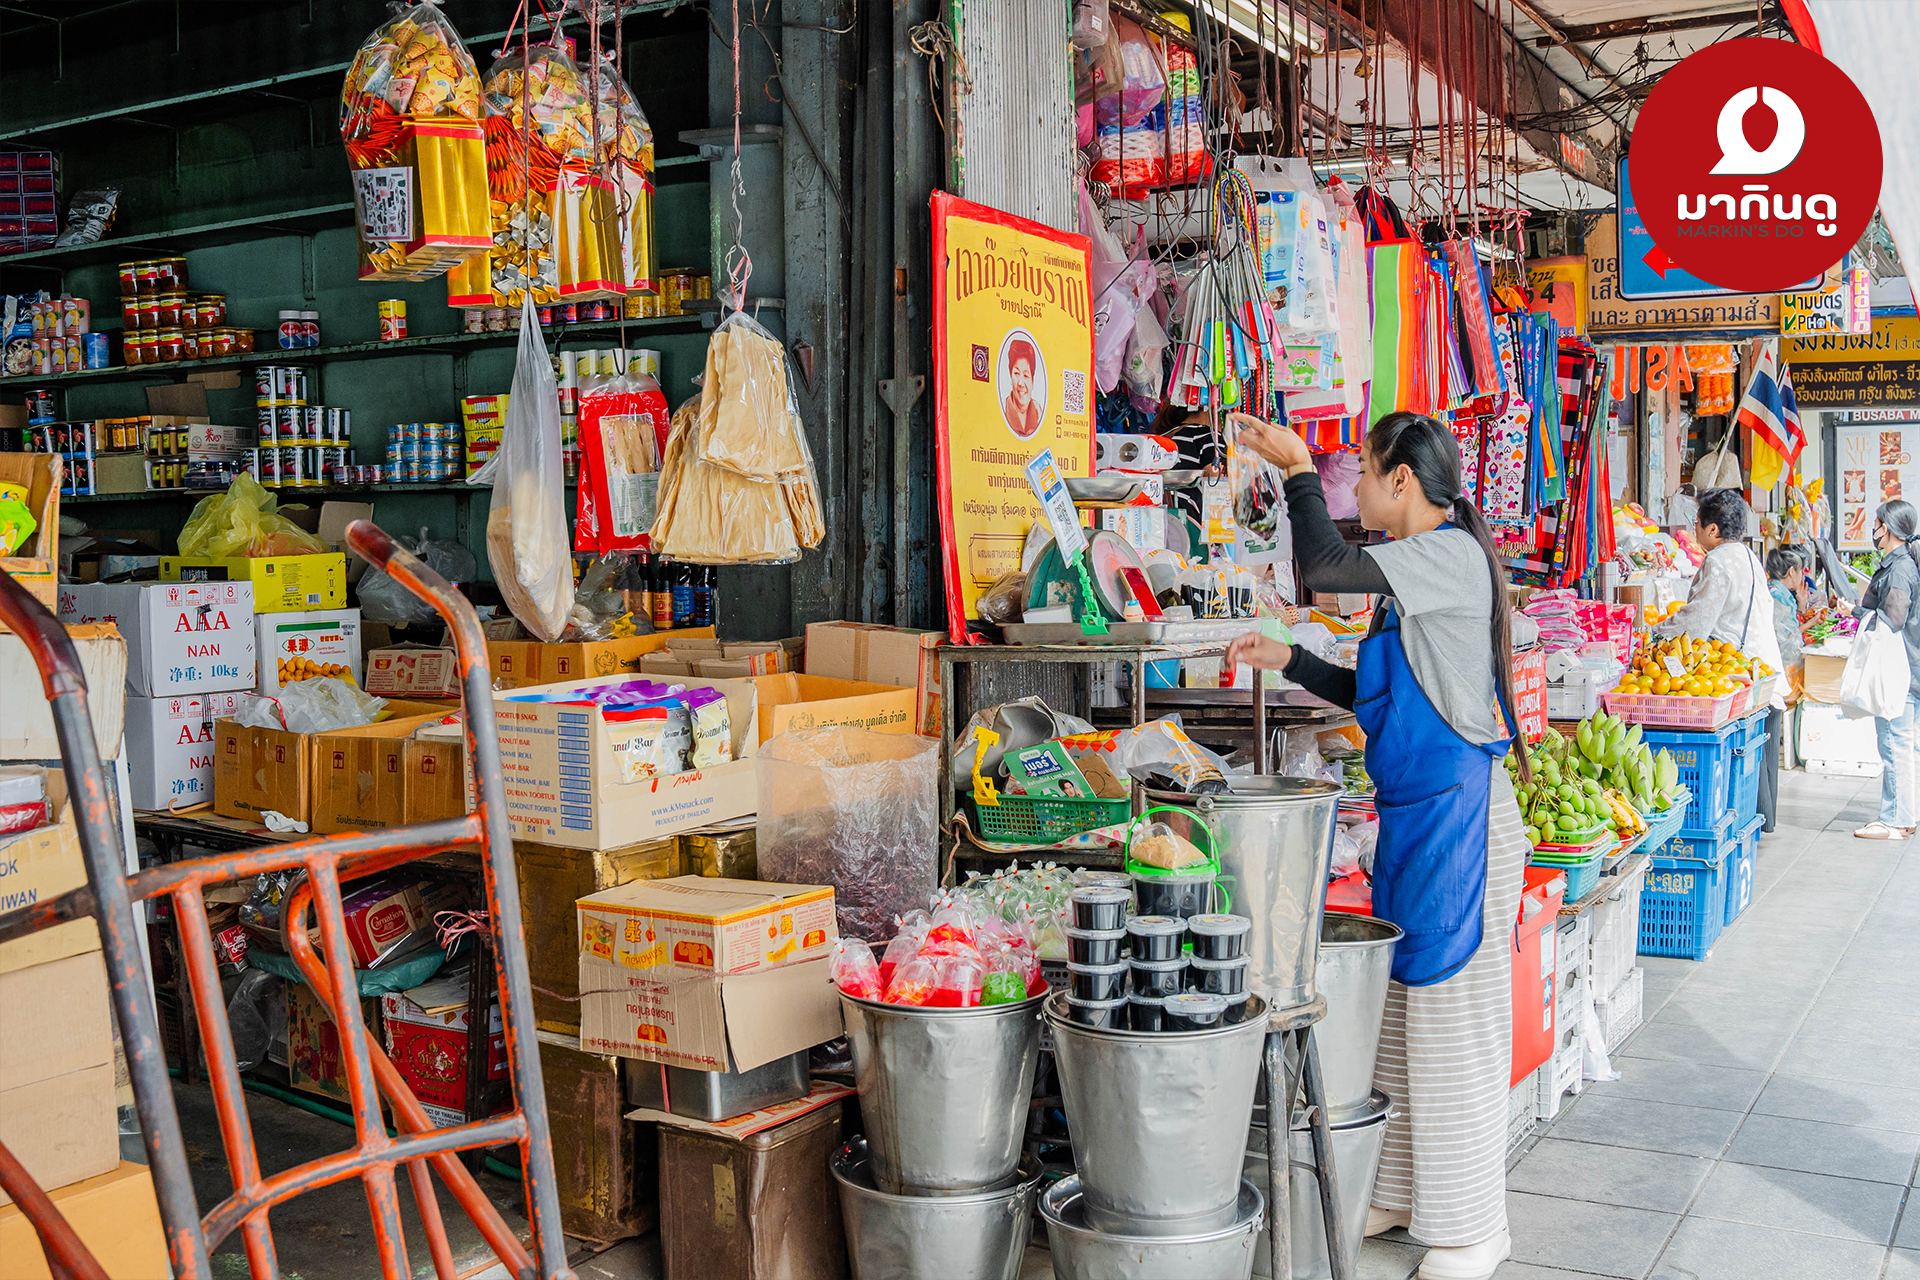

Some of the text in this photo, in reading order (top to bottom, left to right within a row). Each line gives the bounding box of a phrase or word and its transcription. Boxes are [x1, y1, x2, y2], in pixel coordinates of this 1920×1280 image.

[1853, 269, 1869, 333] PHOTO
[1591, 296, 1771, 326] และ อาหารตามสั่ง
[1853, 410, 1905, 421] BUSABA
[1057, 457, 1069, 471] 40
[1071, 456, 1078, 472] ปี
[174, 610, 231, 633] AAA
[187, 643, 220, 658] NAN
[287, 638, 310, 653] 果源
[211, 664, 239, 678] 10kg
[521, 712, 539, 721] SNACK
[889, 709, 907, 723] จำกัด
[176, 724, 214, 745] AA
[519, 738, 531, 746] BAR
[612, 736, 654, 752] anut Bar
[500, 750, 516, 758] SAME
[502, 763, 530, 772] SAME BAR
[516, 777, 537, 786] SESAME
[539, 779, 550, 787] BAR
[506, 788, 555, 800] DURIAN TOOBTUB
[509, 801, 557, 813] COCONUT TOOBTUB
[651, 795, 714, 817] www.KMsnack.com
[508, 814, 551, 826] NGER TOOBTUB
[655, 807, 711, 827] PRODUCT OF THAILAND
[527, 825, 536, 833] 24
[0, 858, 18, 877] OK
[1, 887, 37, 911] IWAN
[371, 909, 404, 931] Carnation
[638, 994, 662, 1005] FRAGILE
[626, 1003, 675, 1026] โปรดอย่าโยน
